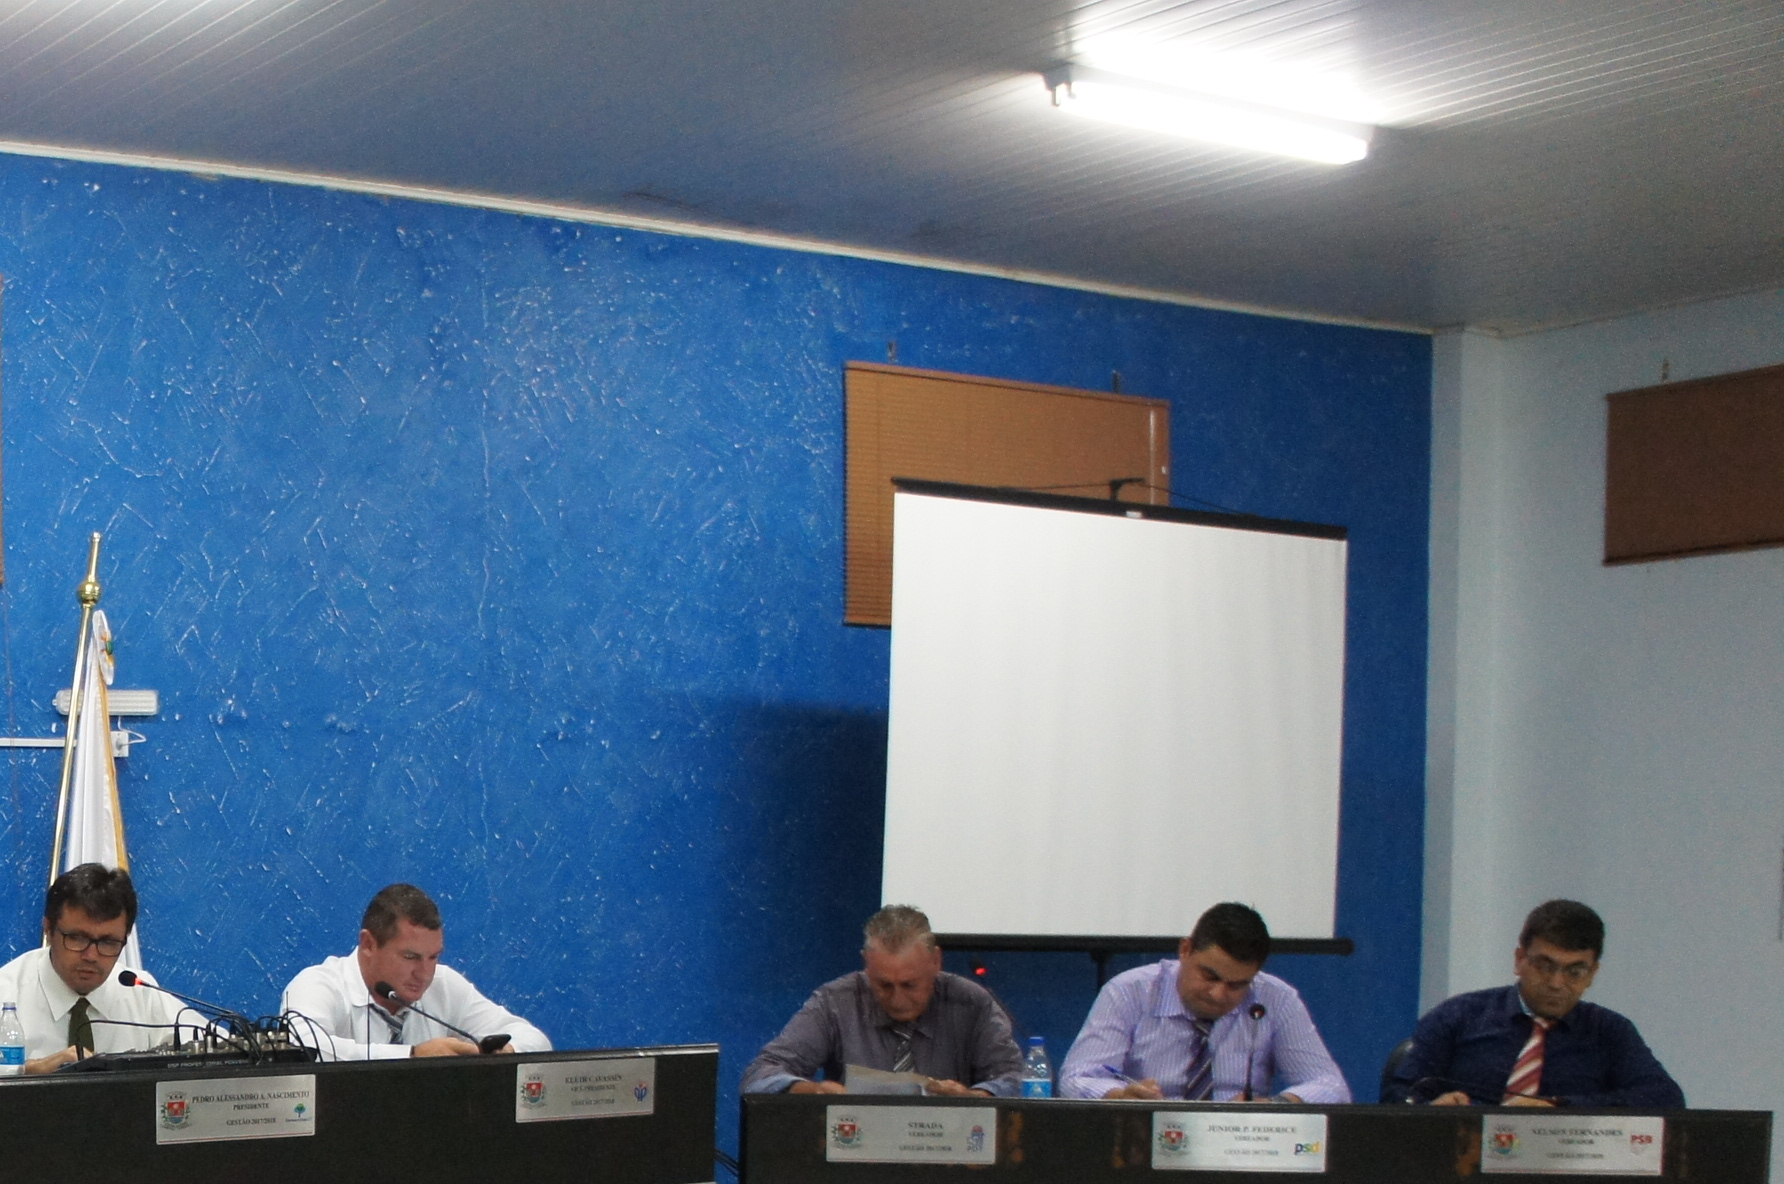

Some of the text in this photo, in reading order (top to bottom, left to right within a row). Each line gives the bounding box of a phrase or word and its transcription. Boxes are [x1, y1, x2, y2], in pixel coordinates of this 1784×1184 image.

[216, 1093, 258, 1102] ALESSANDRO
[267, 1091, 309, 1099] NASCIMENTO
[227, 1118, 250, 1126] GESTÃO
